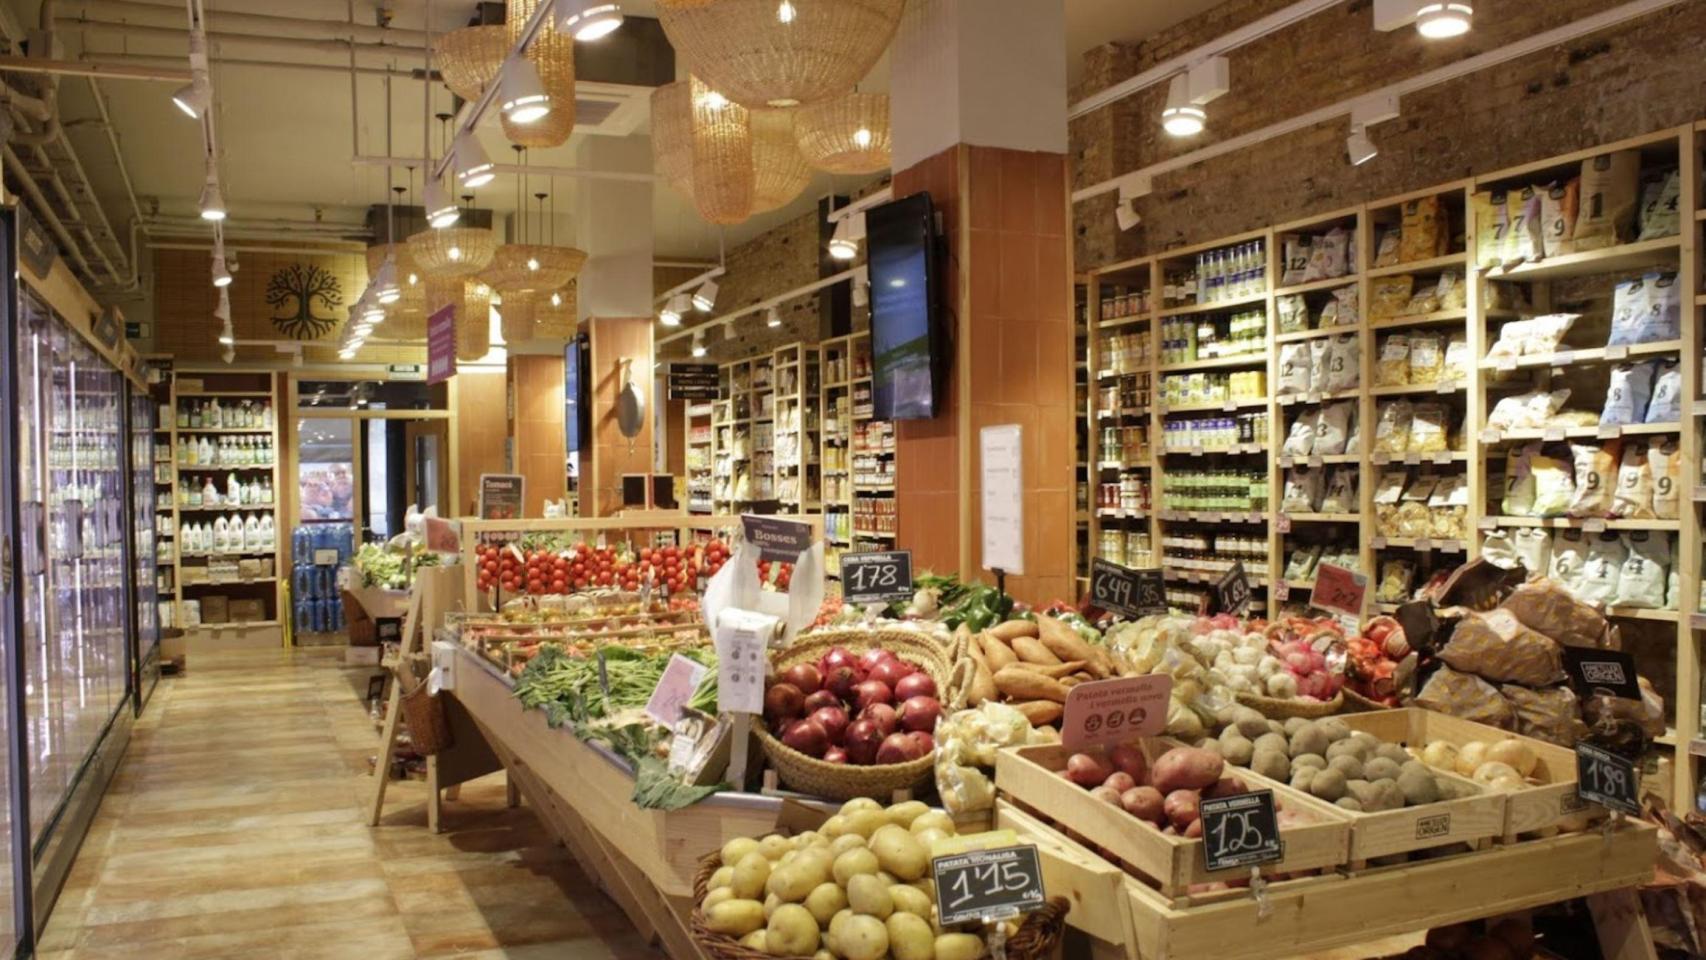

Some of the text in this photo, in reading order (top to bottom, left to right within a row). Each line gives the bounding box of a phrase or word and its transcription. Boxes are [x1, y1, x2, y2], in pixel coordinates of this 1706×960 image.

[1590, 192, 1603, 218] 1
[1493, 224, 1504, 240] 7
[1513, 215, 1525, 232] 7
[1554, 219, 1565, 236] 9
[1290, 257, 1307, 270] 12
[1281, 363, 1293, 377] 12
[1507, 475, 1517, 491] 7
[1587, 472, 1600, 490] 9
[1626, 472, 1639, 489] 9
[1658, 477, 1672, 495] 9
[754, 529, 797, 544] Bosses
[1556, 557, 1569, 574] 6
[1587, 671, 1623, 682] ORIGEN
[1076, 684, 1153, 701] Patata vermella
[1586, 759, 1627, 796] 1'89
[1211, 809, 1263, 857] 1'25
[938, 858, 969, 869] PATATA
[949, 861, 1030, 909] 1'15
